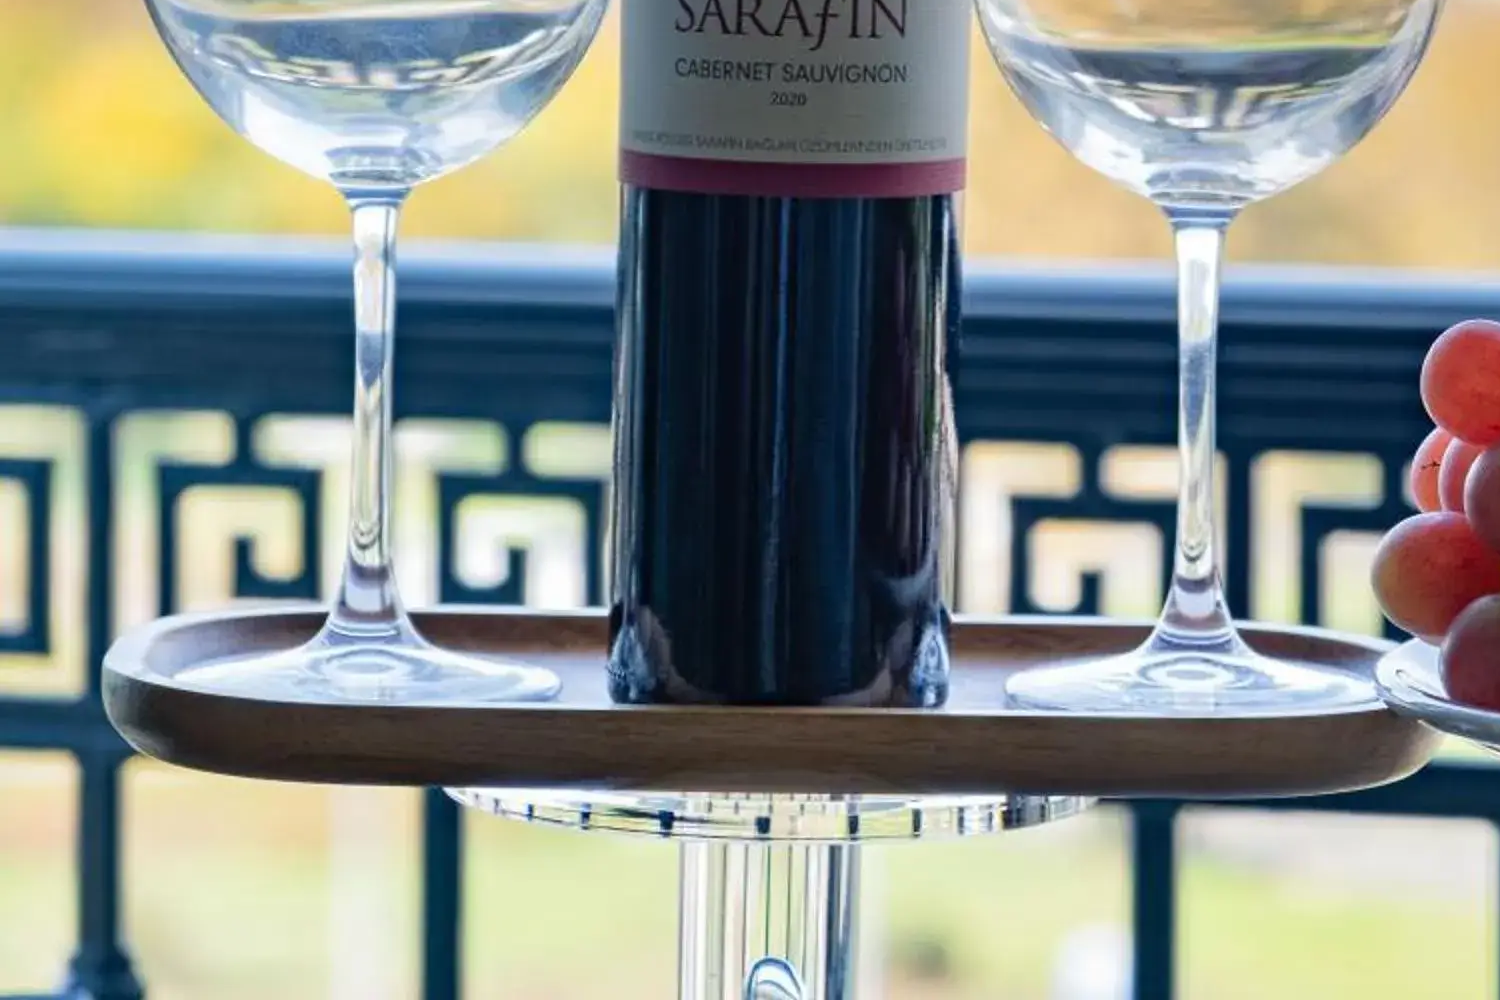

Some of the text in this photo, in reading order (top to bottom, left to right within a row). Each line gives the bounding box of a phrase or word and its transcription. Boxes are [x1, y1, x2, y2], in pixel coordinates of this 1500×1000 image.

[674, 57, 908, 84] CABERNET SAUVIGNON
[769, 91, 808, 107] 2020
